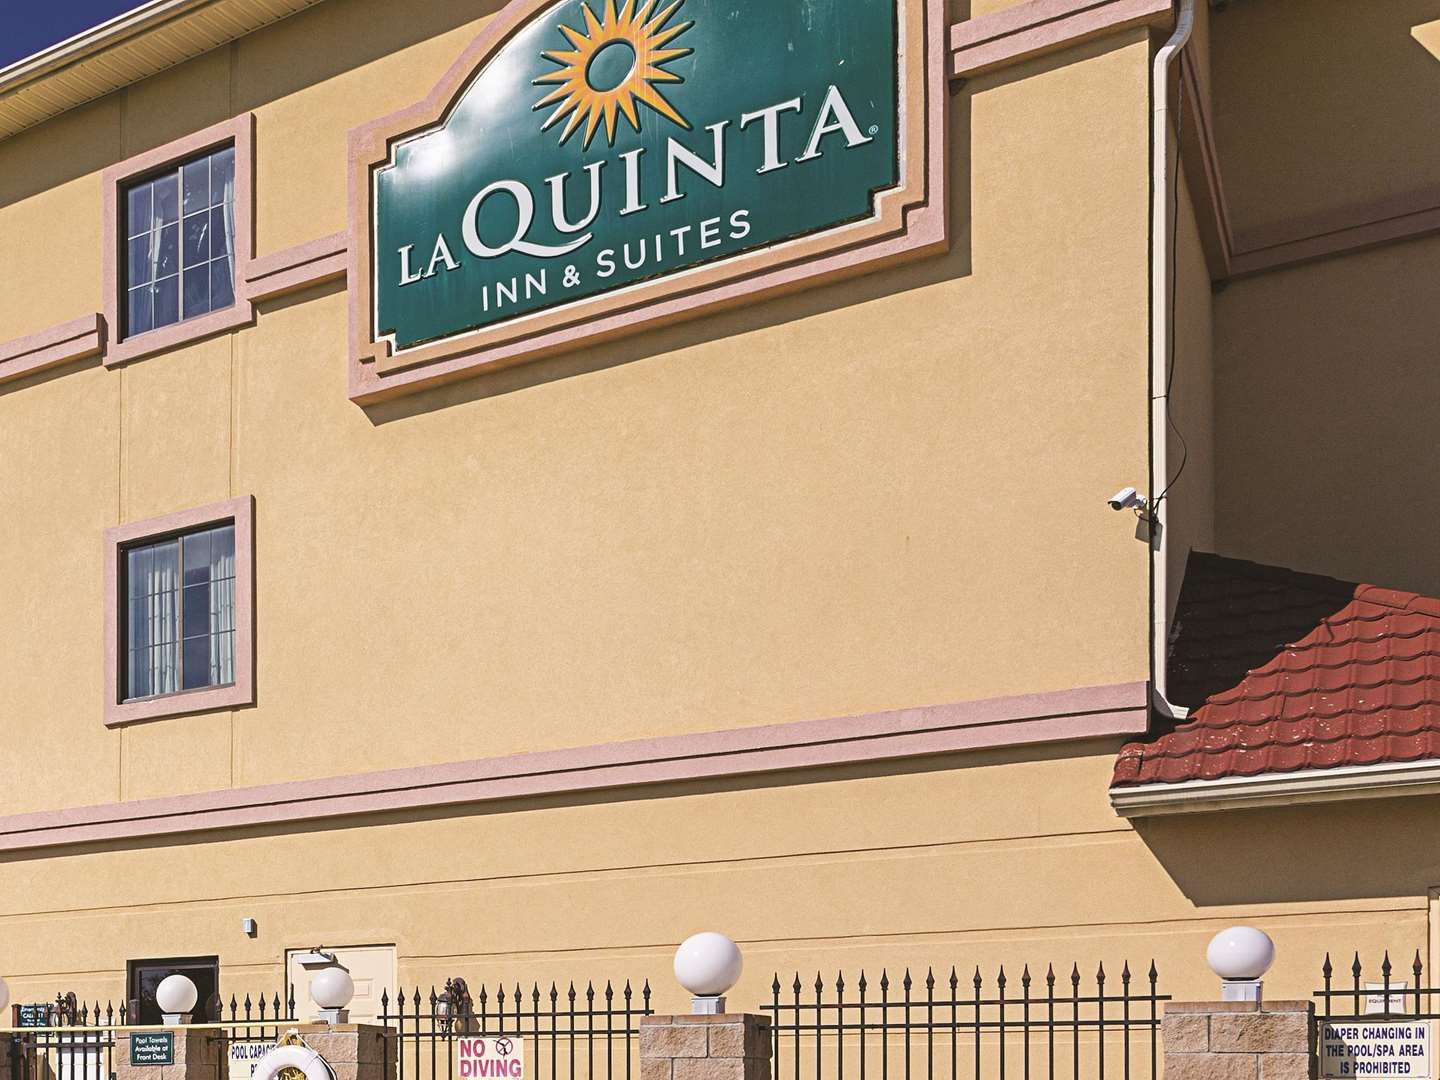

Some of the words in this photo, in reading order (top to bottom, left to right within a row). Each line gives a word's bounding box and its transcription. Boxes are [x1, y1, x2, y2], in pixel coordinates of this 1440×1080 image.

[398, 233, 461, 286] LA
[461, 84, 873, 259] QUINTA
[482, 268, 547, 312] INN
[562, 264, 581, 288] &
[596, 209, 752, 278] SUITES
[135, 1036, 148, 1044] Pool
[1325, 1027, 1359, 1040] DIAPER
[1362, 1027, 1412, 1039] CHANGING
[1415, 1027, 1425, 1039] IN
[232, 1045, 248, 1060] POOL
[460, 1039, 486, 1057] NO
[1326, 1044, 1344, 1057] THE
[1347, 1043, 1395, 1058] POOL/SPA
[1398, 1044, 1425, 1057] AREA
[460, 1059, 522, 1078] DIVING
[1340, 1061, 1349, 1074] IS
[1353, 1061, 1411, 1074] PROHIBITED
